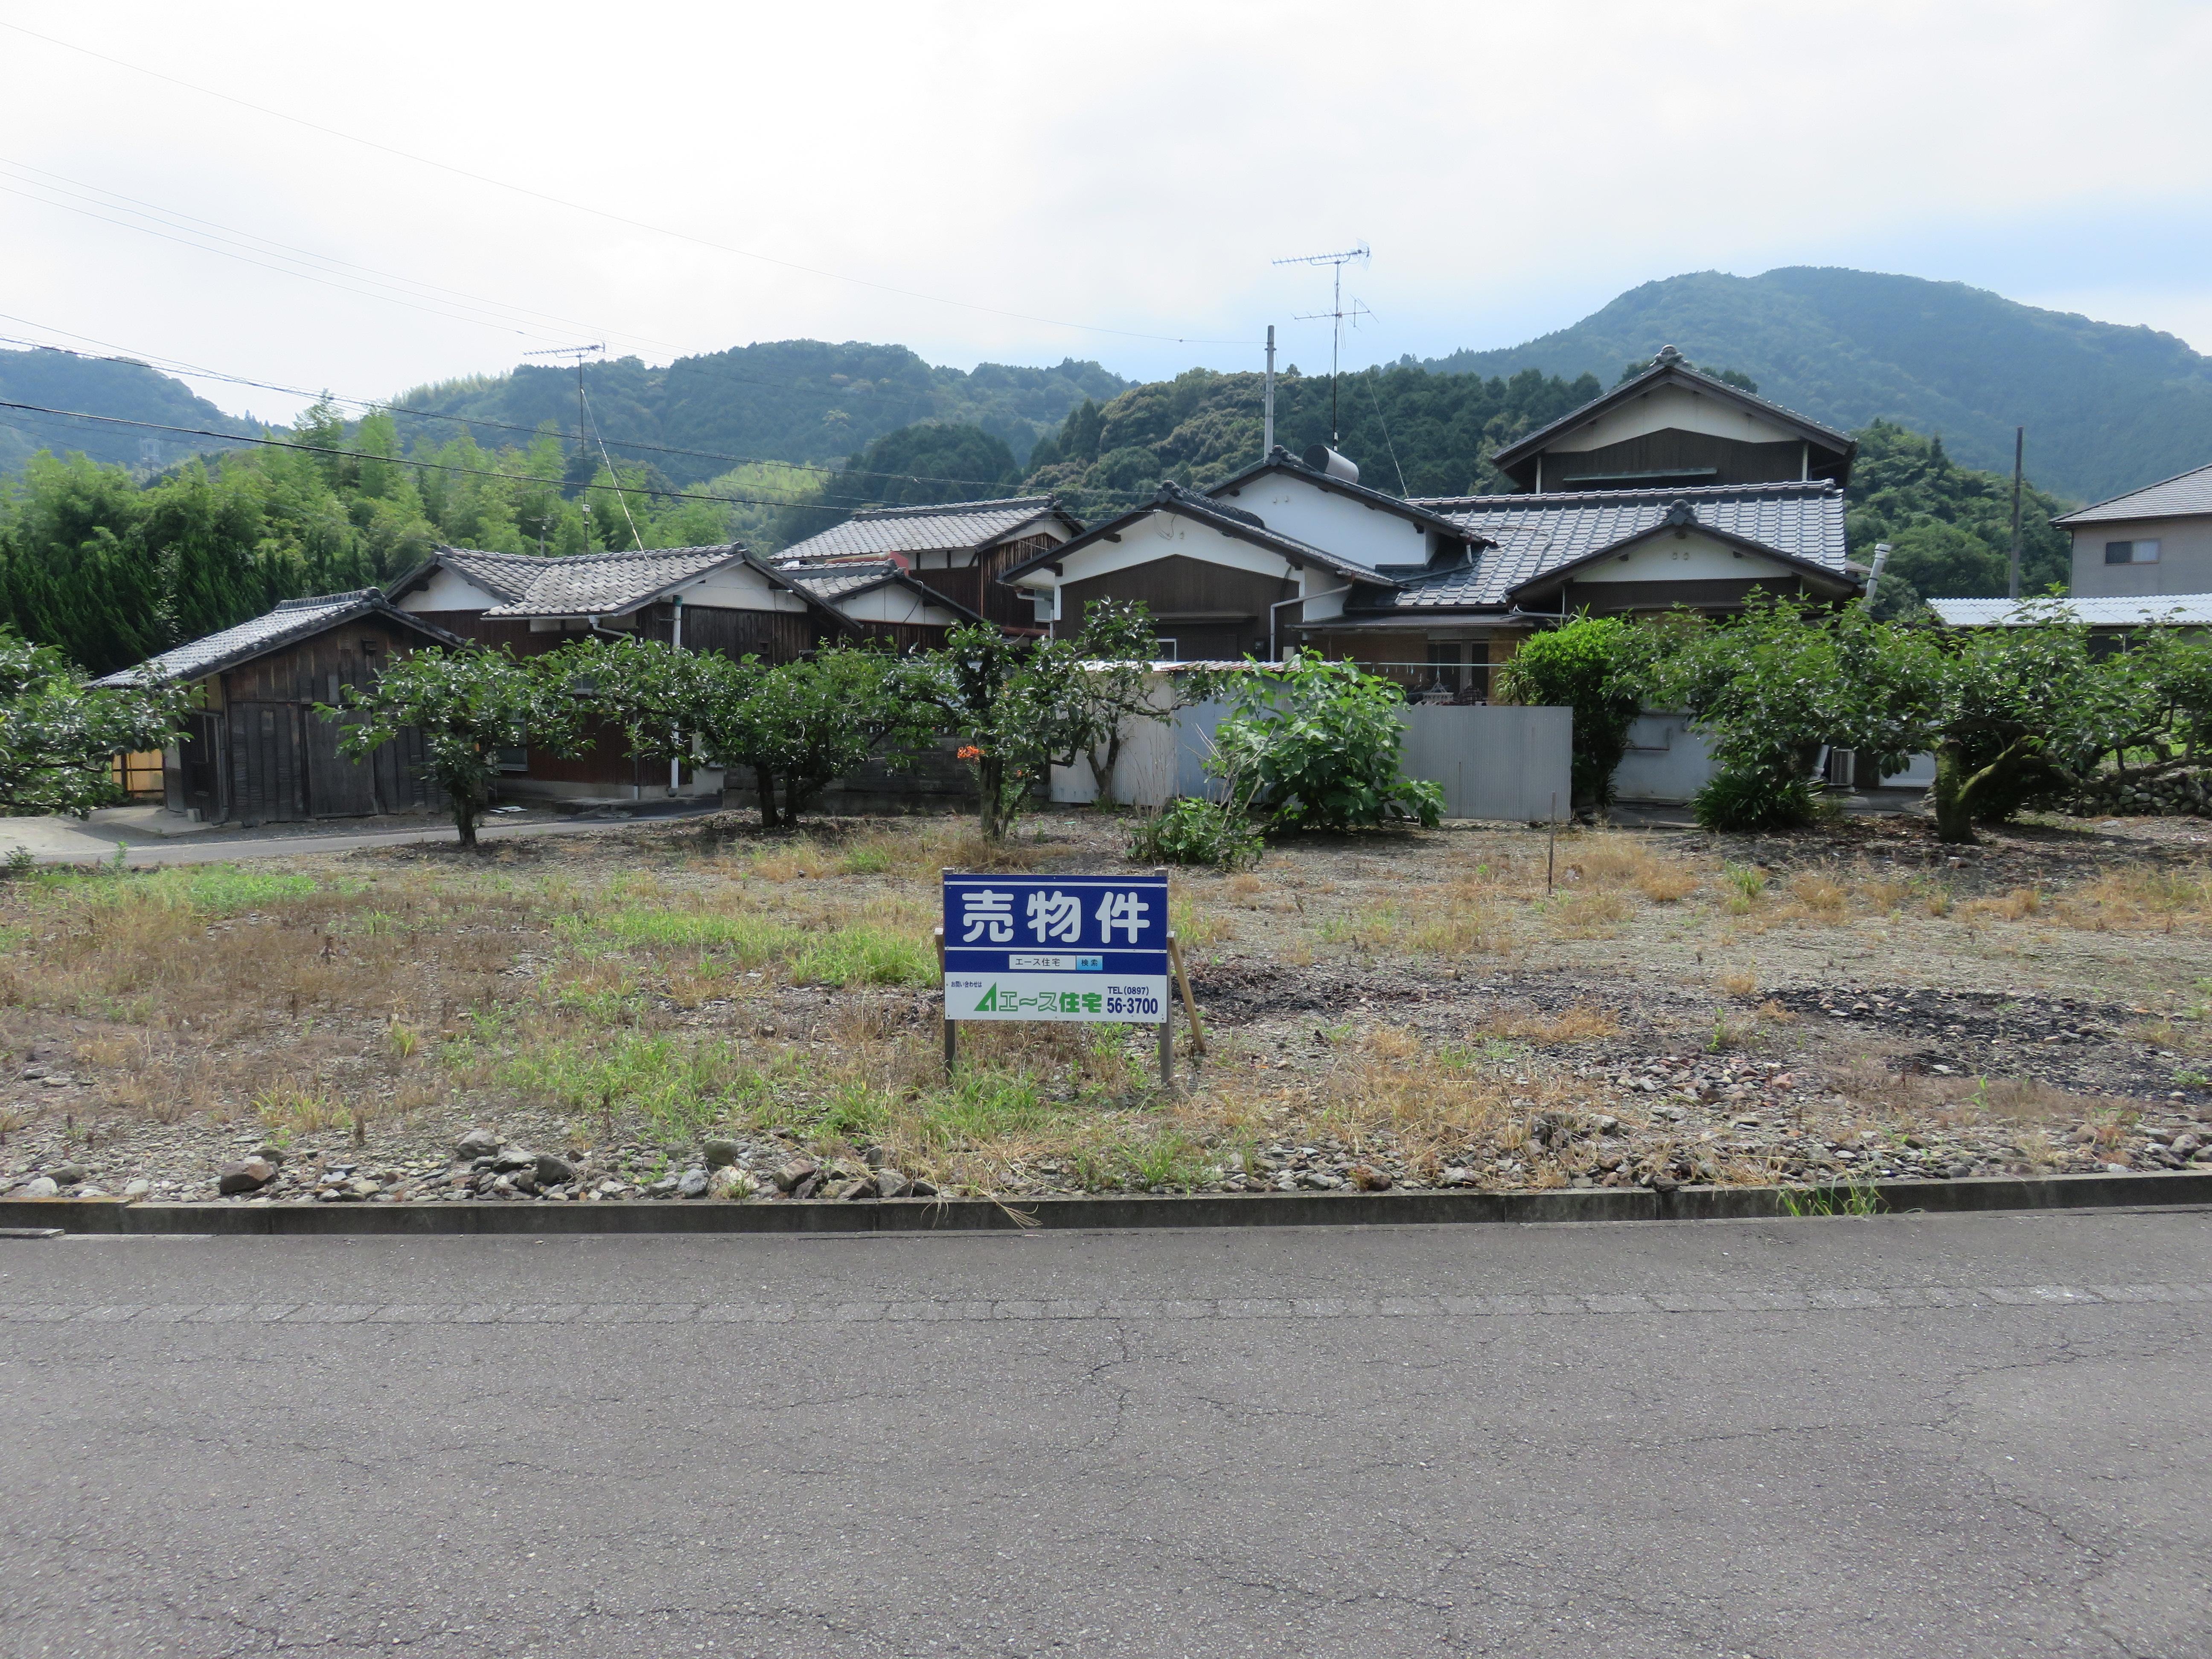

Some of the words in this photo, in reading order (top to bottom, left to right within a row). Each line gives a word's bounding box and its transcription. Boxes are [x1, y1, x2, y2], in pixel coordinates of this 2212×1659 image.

[962, 890, 1150, 943] 売物件
[1015, 958, 1060, 966] エース住宅
[998, 991, 1102, 1013] エース住宅
[1107, 997, 1158, 1014] 56-3700
